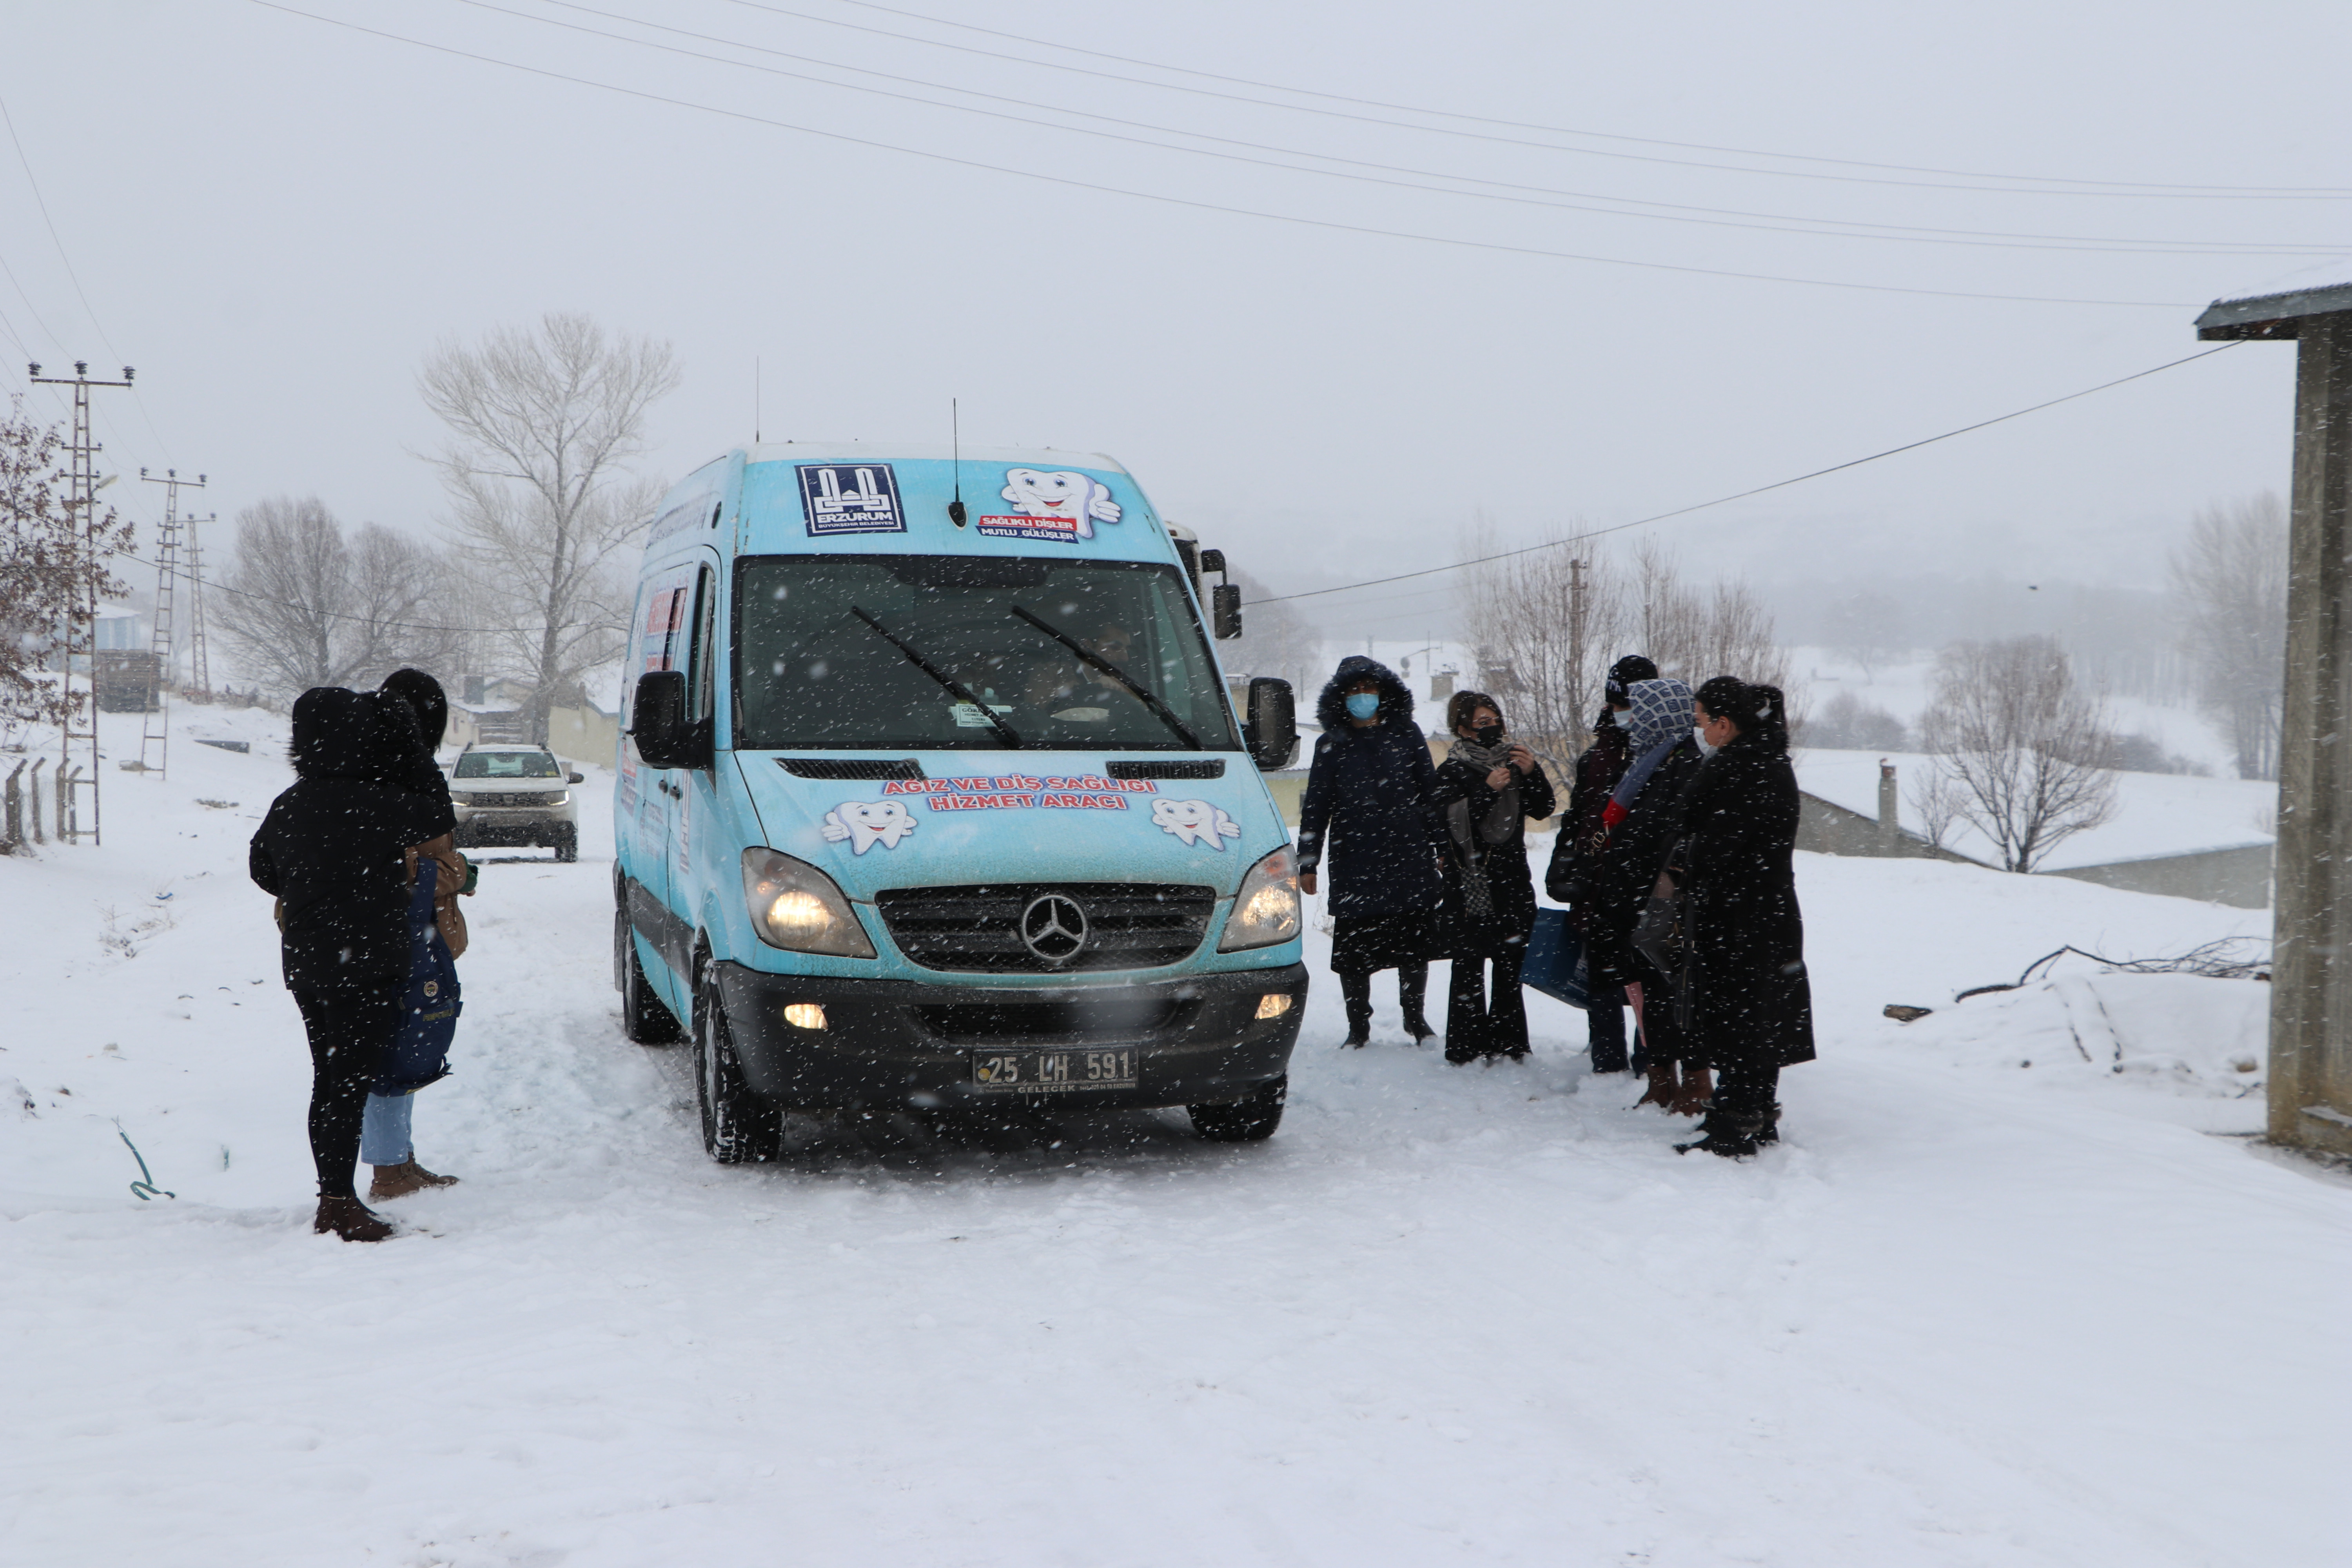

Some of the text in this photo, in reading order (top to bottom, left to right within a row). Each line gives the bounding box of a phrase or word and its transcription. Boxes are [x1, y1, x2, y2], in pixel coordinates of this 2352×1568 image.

[817, 512, 893, 523] ERZURUM
[982, 517, 1074, 529] SAĞLIKLI DİŞLER
[981, 528, 1074, 540] MUTLU GÜLÜŞLER
[884, 779, 951, 795] AĞIZ
[951, 778, 992, 791] VE
[994, 774, 1043, 791] DİŞ
[929, 793, 1127, 811] HİZMET ARACI
[988, 1051, 1129, 1083] 25 LH 591
[1018, 1085, 1075, 1093] GELECEK
